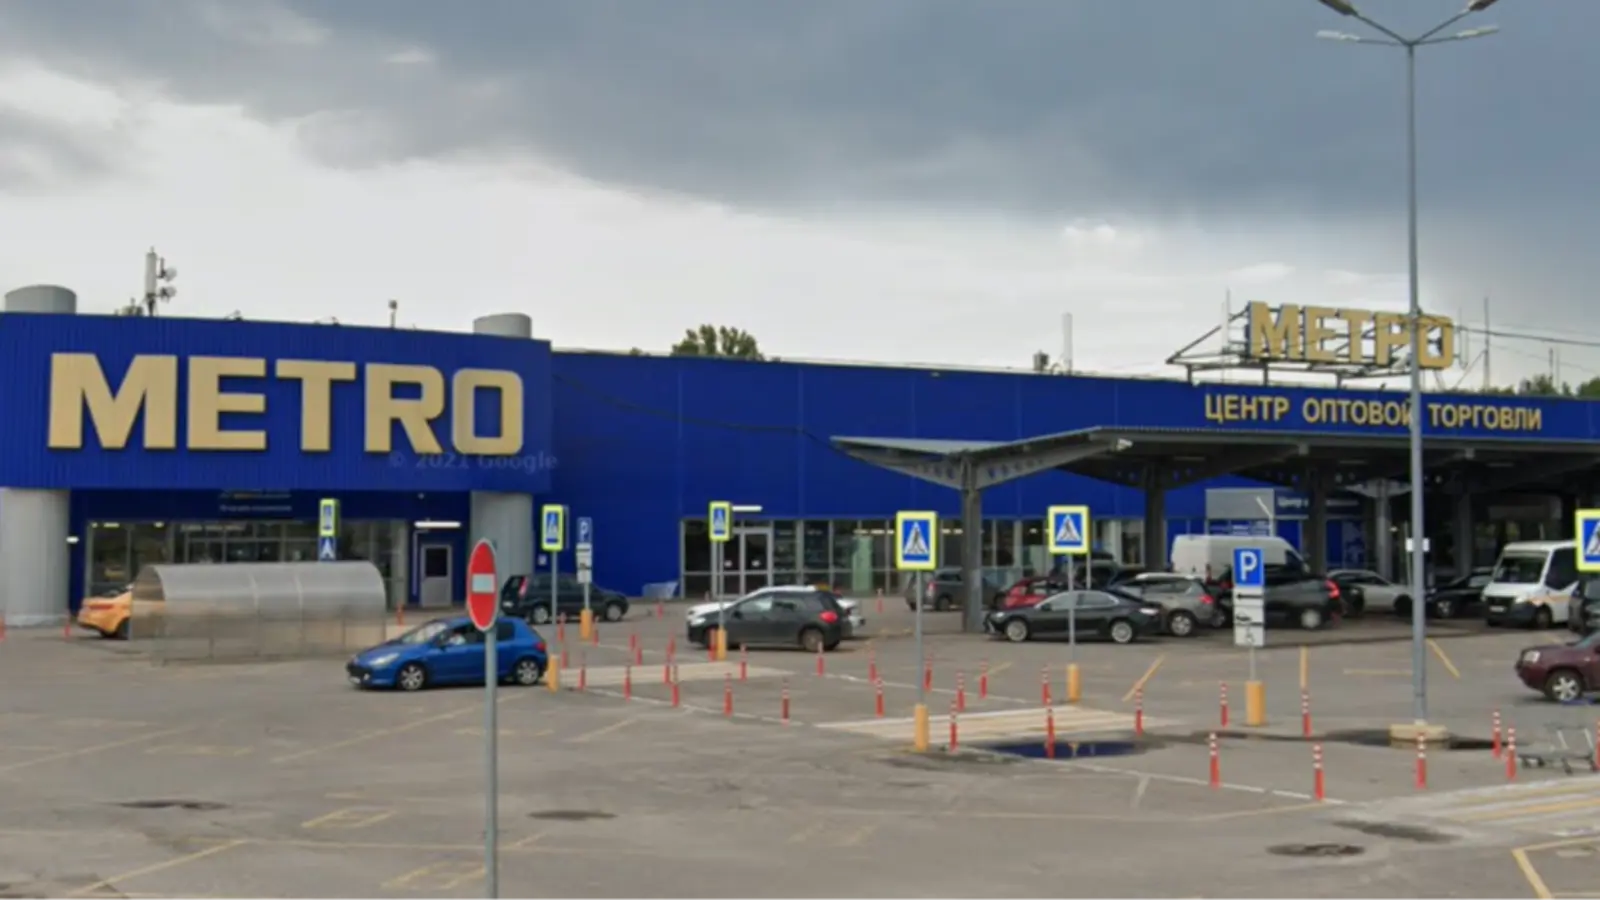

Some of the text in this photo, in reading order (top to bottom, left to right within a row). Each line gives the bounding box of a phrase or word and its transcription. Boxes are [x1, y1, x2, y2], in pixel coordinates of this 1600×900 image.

[1247, 300, 1454, 369] МЕТРО
[48, 353, 524, 455] METRO
[1205, 394, 1290, 424] ЦЕНТР
[1428, 402, 1542, 430] ТОРГОВЛИ
[1239, 550, 1257, 582] P
